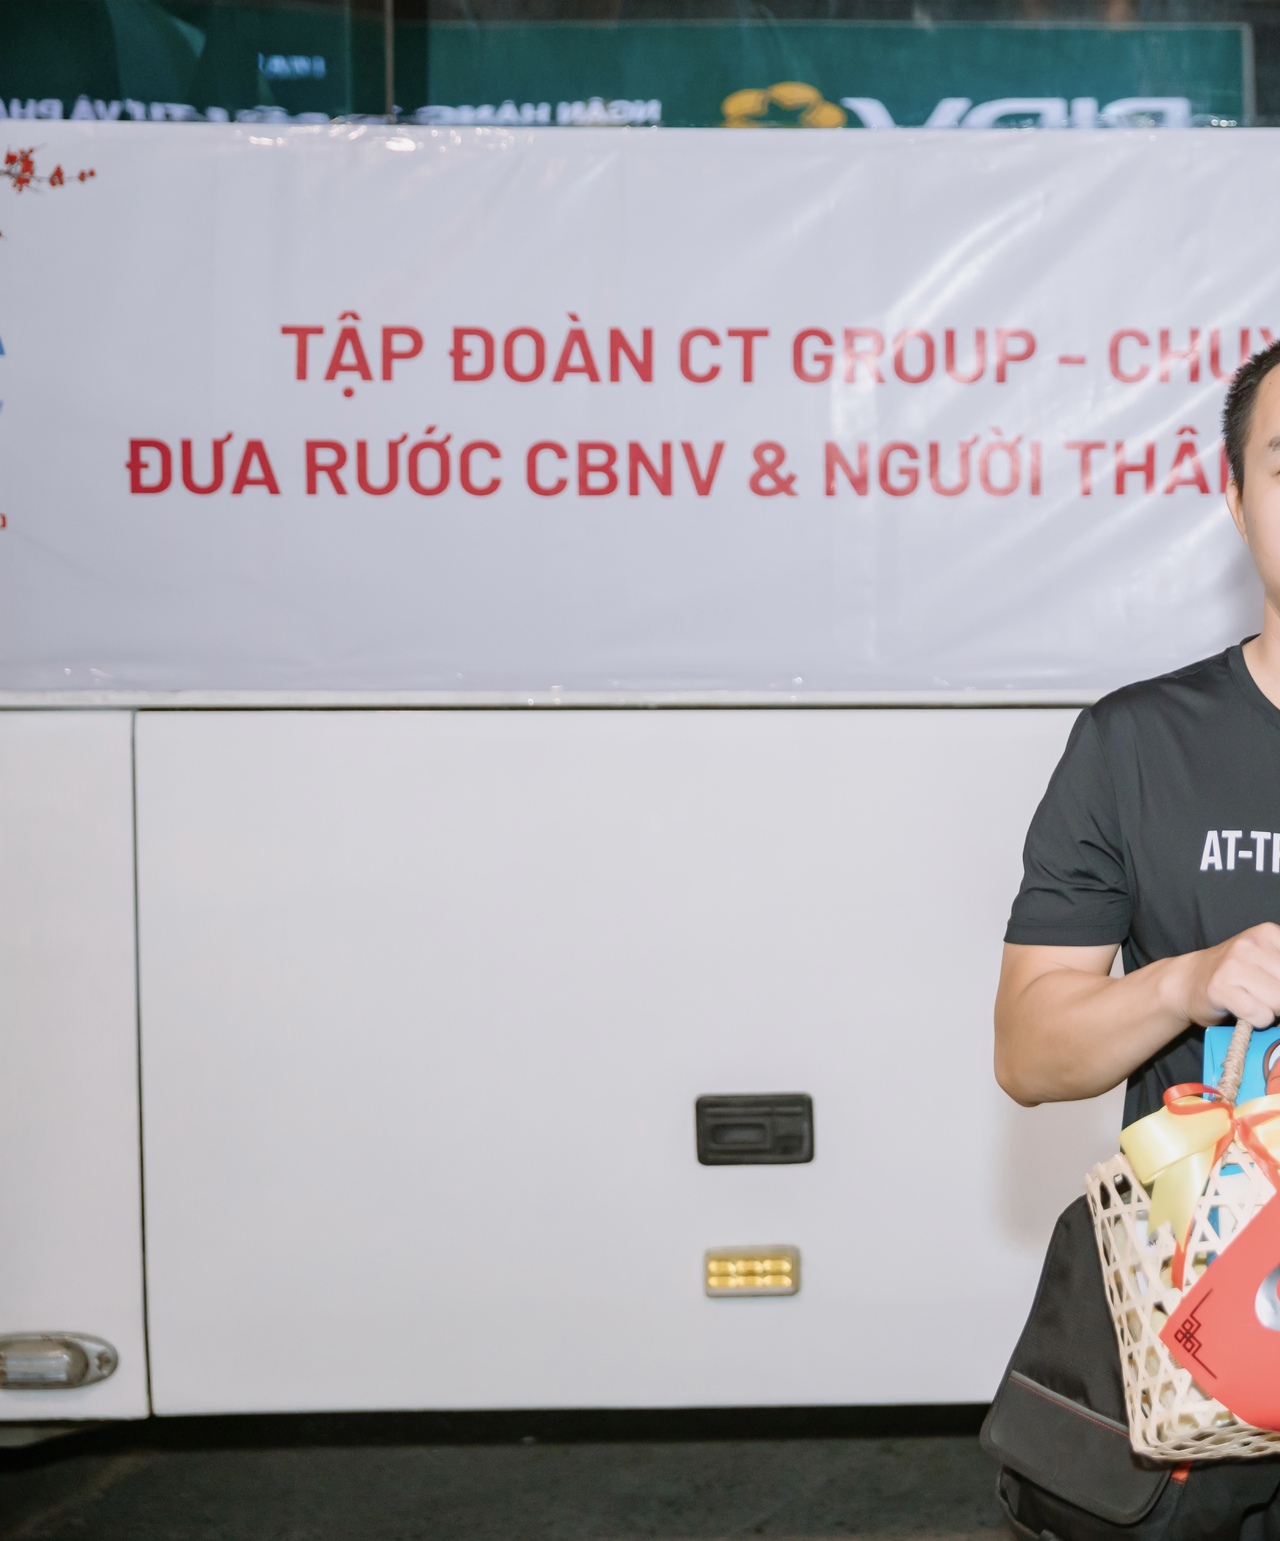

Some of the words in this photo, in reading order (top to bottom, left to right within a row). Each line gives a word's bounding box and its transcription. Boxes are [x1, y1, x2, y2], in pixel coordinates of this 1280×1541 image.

[279, 310, 425, 399] TẬP
[448, 311, 655, 385] ĐOÀN
[678, 326, 771, 385] CT
[791, 326, 1037, 385] GROUP
[125, 431, 282, 497] ĐƯA
[304, 424, 503, 498] RƯỚC
[525, 439, 726, 498] CBNV
[748, 440, 798, 498] &
[823, 426, 1042, 498] NGƯỜI
